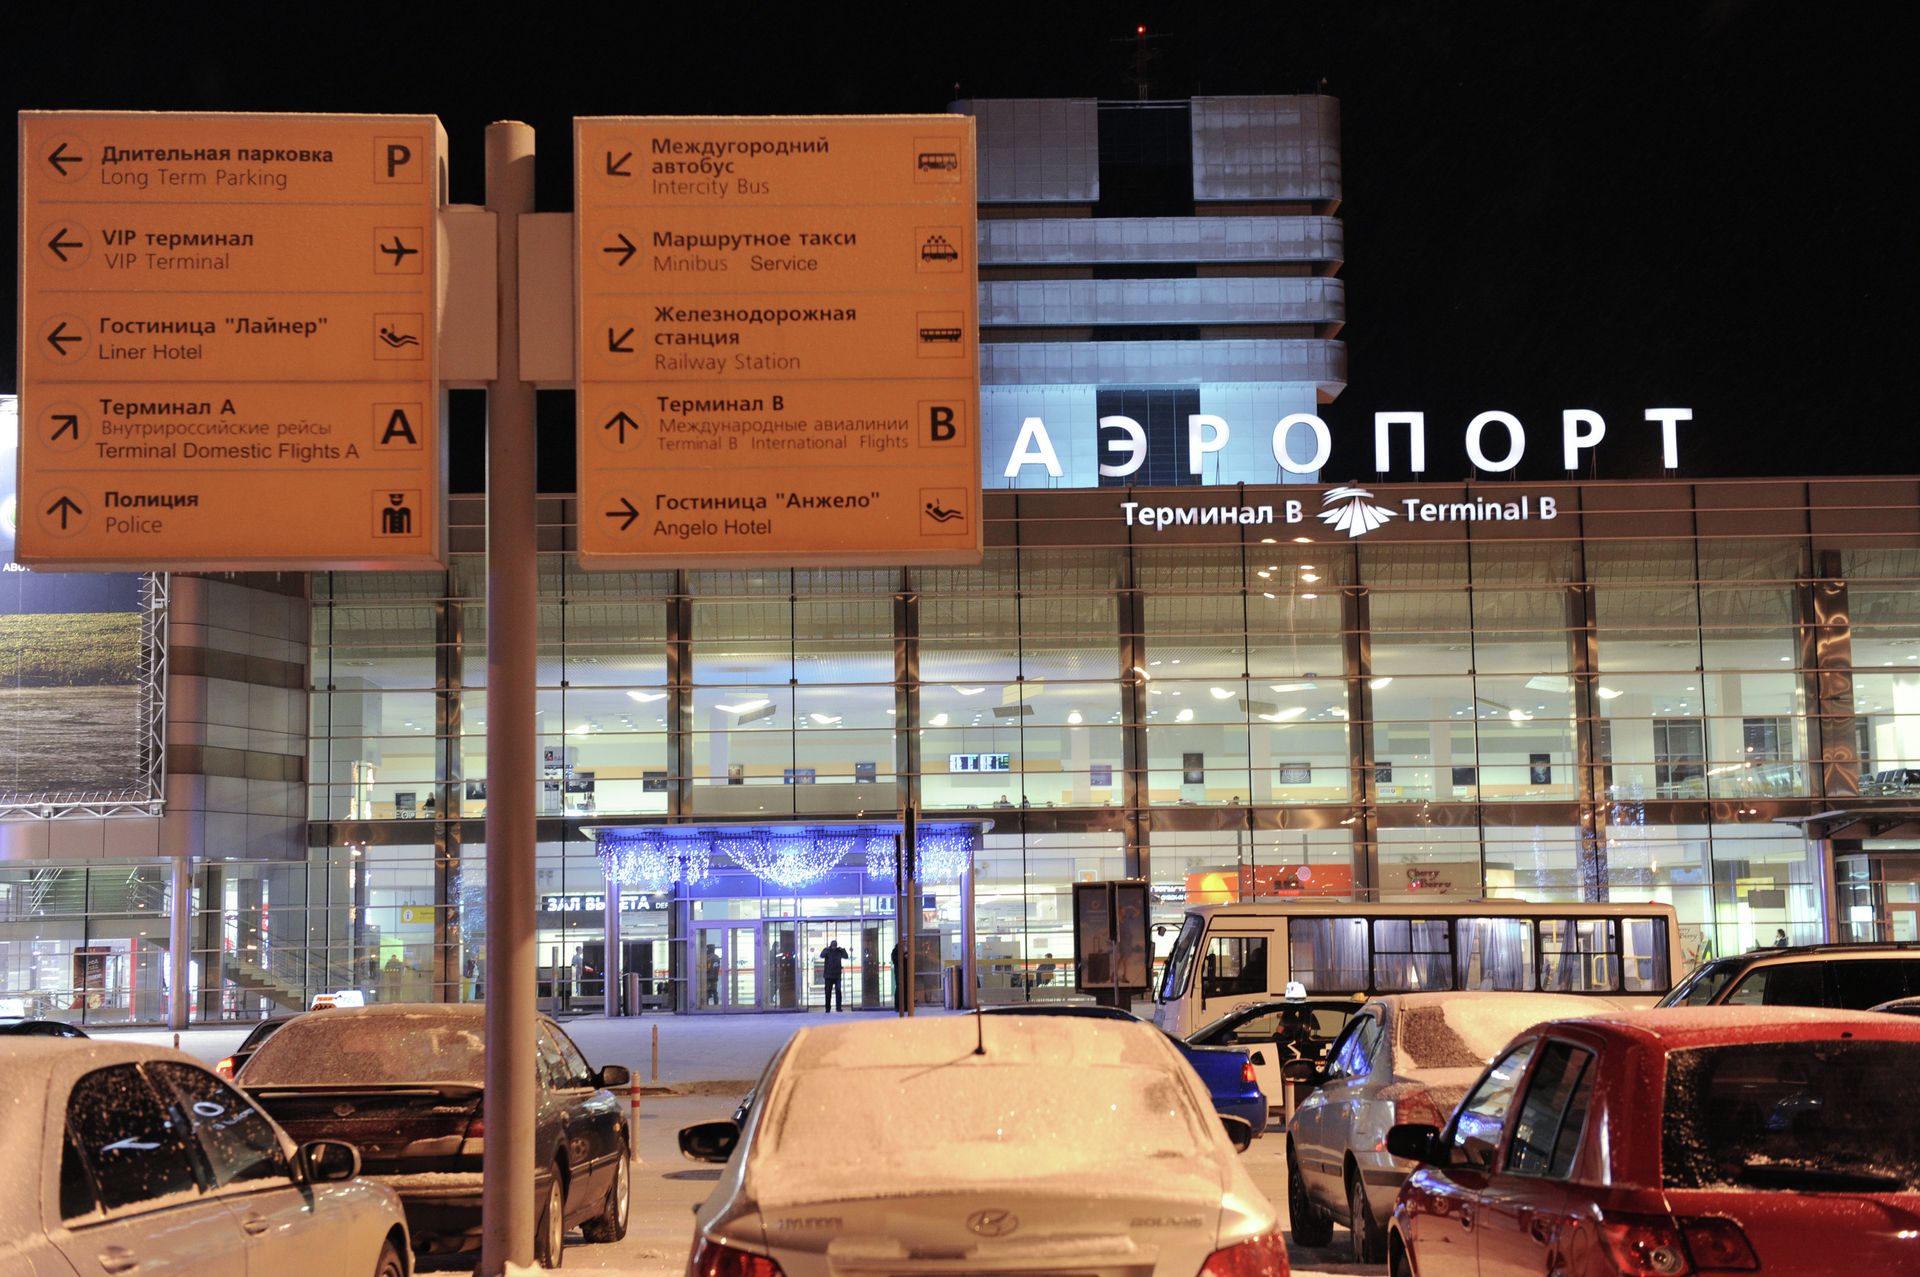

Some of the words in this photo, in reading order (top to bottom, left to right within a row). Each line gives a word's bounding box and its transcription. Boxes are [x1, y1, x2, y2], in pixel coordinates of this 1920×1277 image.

[102, 146, 230, 165] Длительная
[238, 149, 333, 164] парковка
[652, 137, 828, 159] Междугородний
[388, 145, 411, 177] P
[652, 156, 733, 178] автобус
[102, 168, 148, 190] Long
[158, 168, 206, 185] Term
[216, 169, 287, 191] Parking
[653, 175, 728, 198] Intercity
[738, 178, 769, 194] Bus
[102, 230, 136, 245] VIP
[145, 234, 253, 250] терминал
[654, 232, 790, 251] Маршрутное
[799, 234, 856, 245] такси
[105, 253, 136, 269] VIP
[145, 253, 229, 270] Terminal
[654, 255, 727, 271] Minibus
[751, 255, 817, 271] Service
[655, 307, 856, 325] Железнодорожная
[100, 318, 215, 336] Гостиница
[226, 317, 327, 338] "Лайнер"
[655, 333, 739, 347] станция
[99, 344, 146, 359] Liner
[154, 344, 202, 359] Hotel
[655, 353, 726, 375] Railway
[735, 353, 800, 370] Station
[100, 399, 210, 419] Терминал
[657, 396, 763, 416] Терминал
[102, 418, 269, 439] Внутрироссийские
[277, 420, 331, 438] рейсы
[381, 409, 416, 444] A
[660, 415, 807, 437] Международные
[814, 420, 908, 431] авиалинии
[931, 407, 956, 441] B
[96, 442, 176, 458] Terminal
[184, 442, 272, 458] Domestic
[279, 443, 340, 463] Flights
[344, 443, 359, 458] A
[657, 433, 721, 451] Terminal
[729, 436, 737, 450] B
[752, 433, 847, 450] International
[860, 434, 908, 452] Flights
[1004, 409, 1692, 478] АЭРОПОРТ
[105, 492, 198, 509] Полиция
[656, 495, 766, 511] Гостиница
[776, 492, 879, 508] "Анжело"
[1402, 498, 1529, 521] Terminal
[1540, 498, 1557, 520] B
[106, 516, 162, 533] Police
[1121, 502, 1274, 529] Терминал
[653, 520, 718, 539] Angelo
[725, 519, 771, 535] Hotel
[547, 897, 580, 911] ЗАЛ
